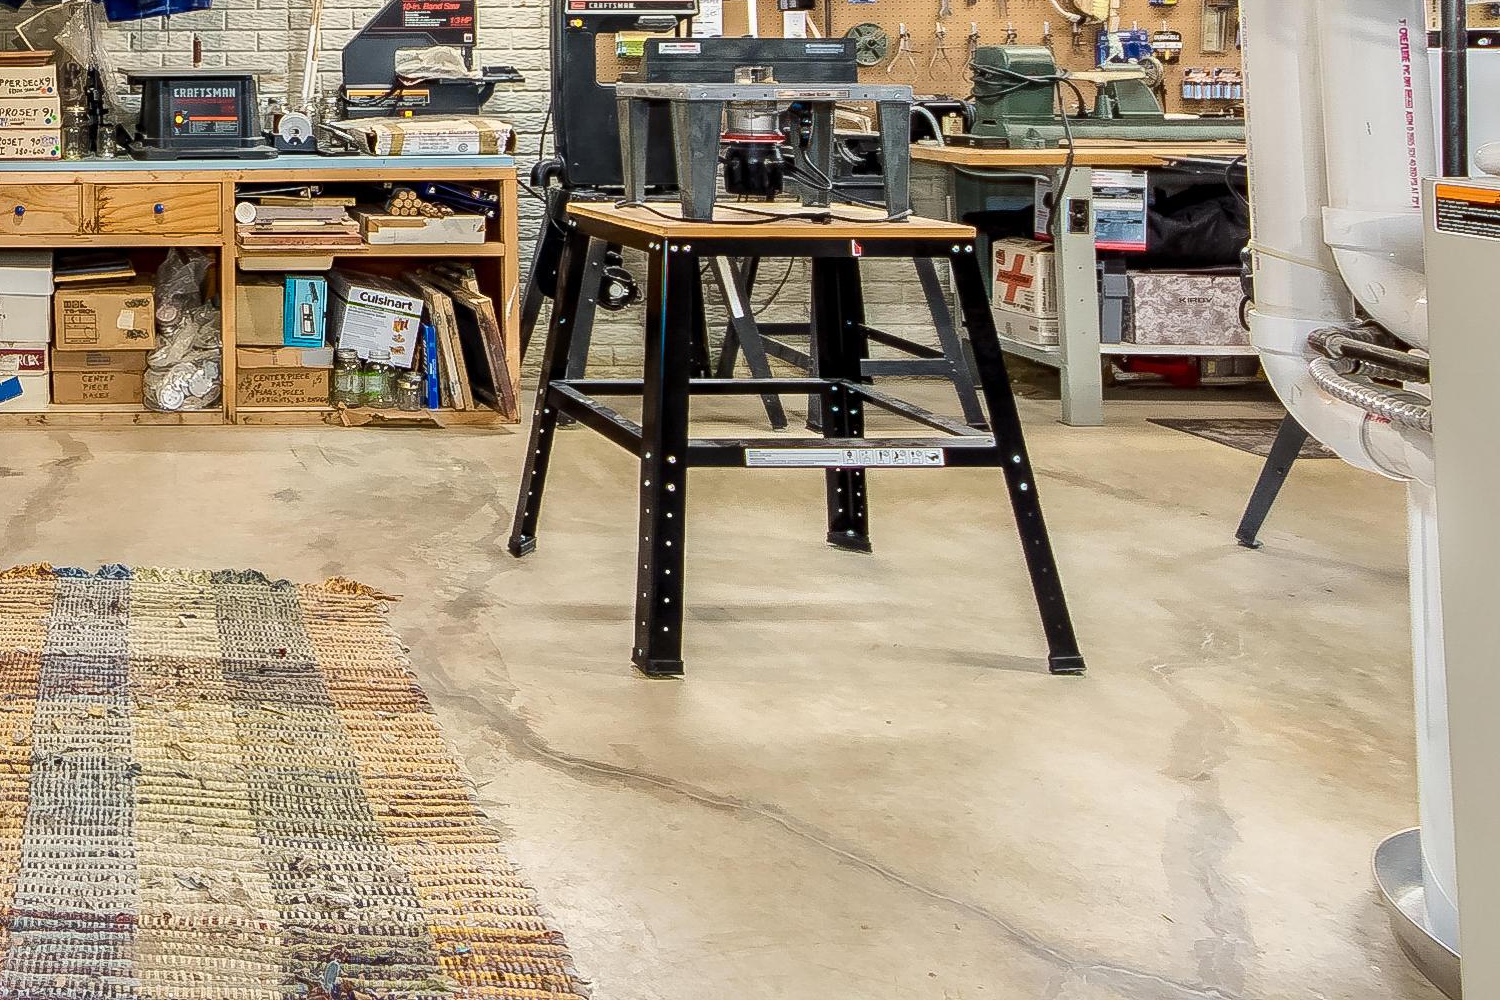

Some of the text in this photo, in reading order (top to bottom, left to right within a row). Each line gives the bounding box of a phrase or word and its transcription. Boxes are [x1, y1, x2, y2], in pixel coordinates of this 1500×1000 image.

[443, 2, 460, 10] Saw
[173, 87, 236, 98] CRAFTSMAN
[42, 107, 54, 118] 91
[359, 291, 413, 311] Cuisinart
